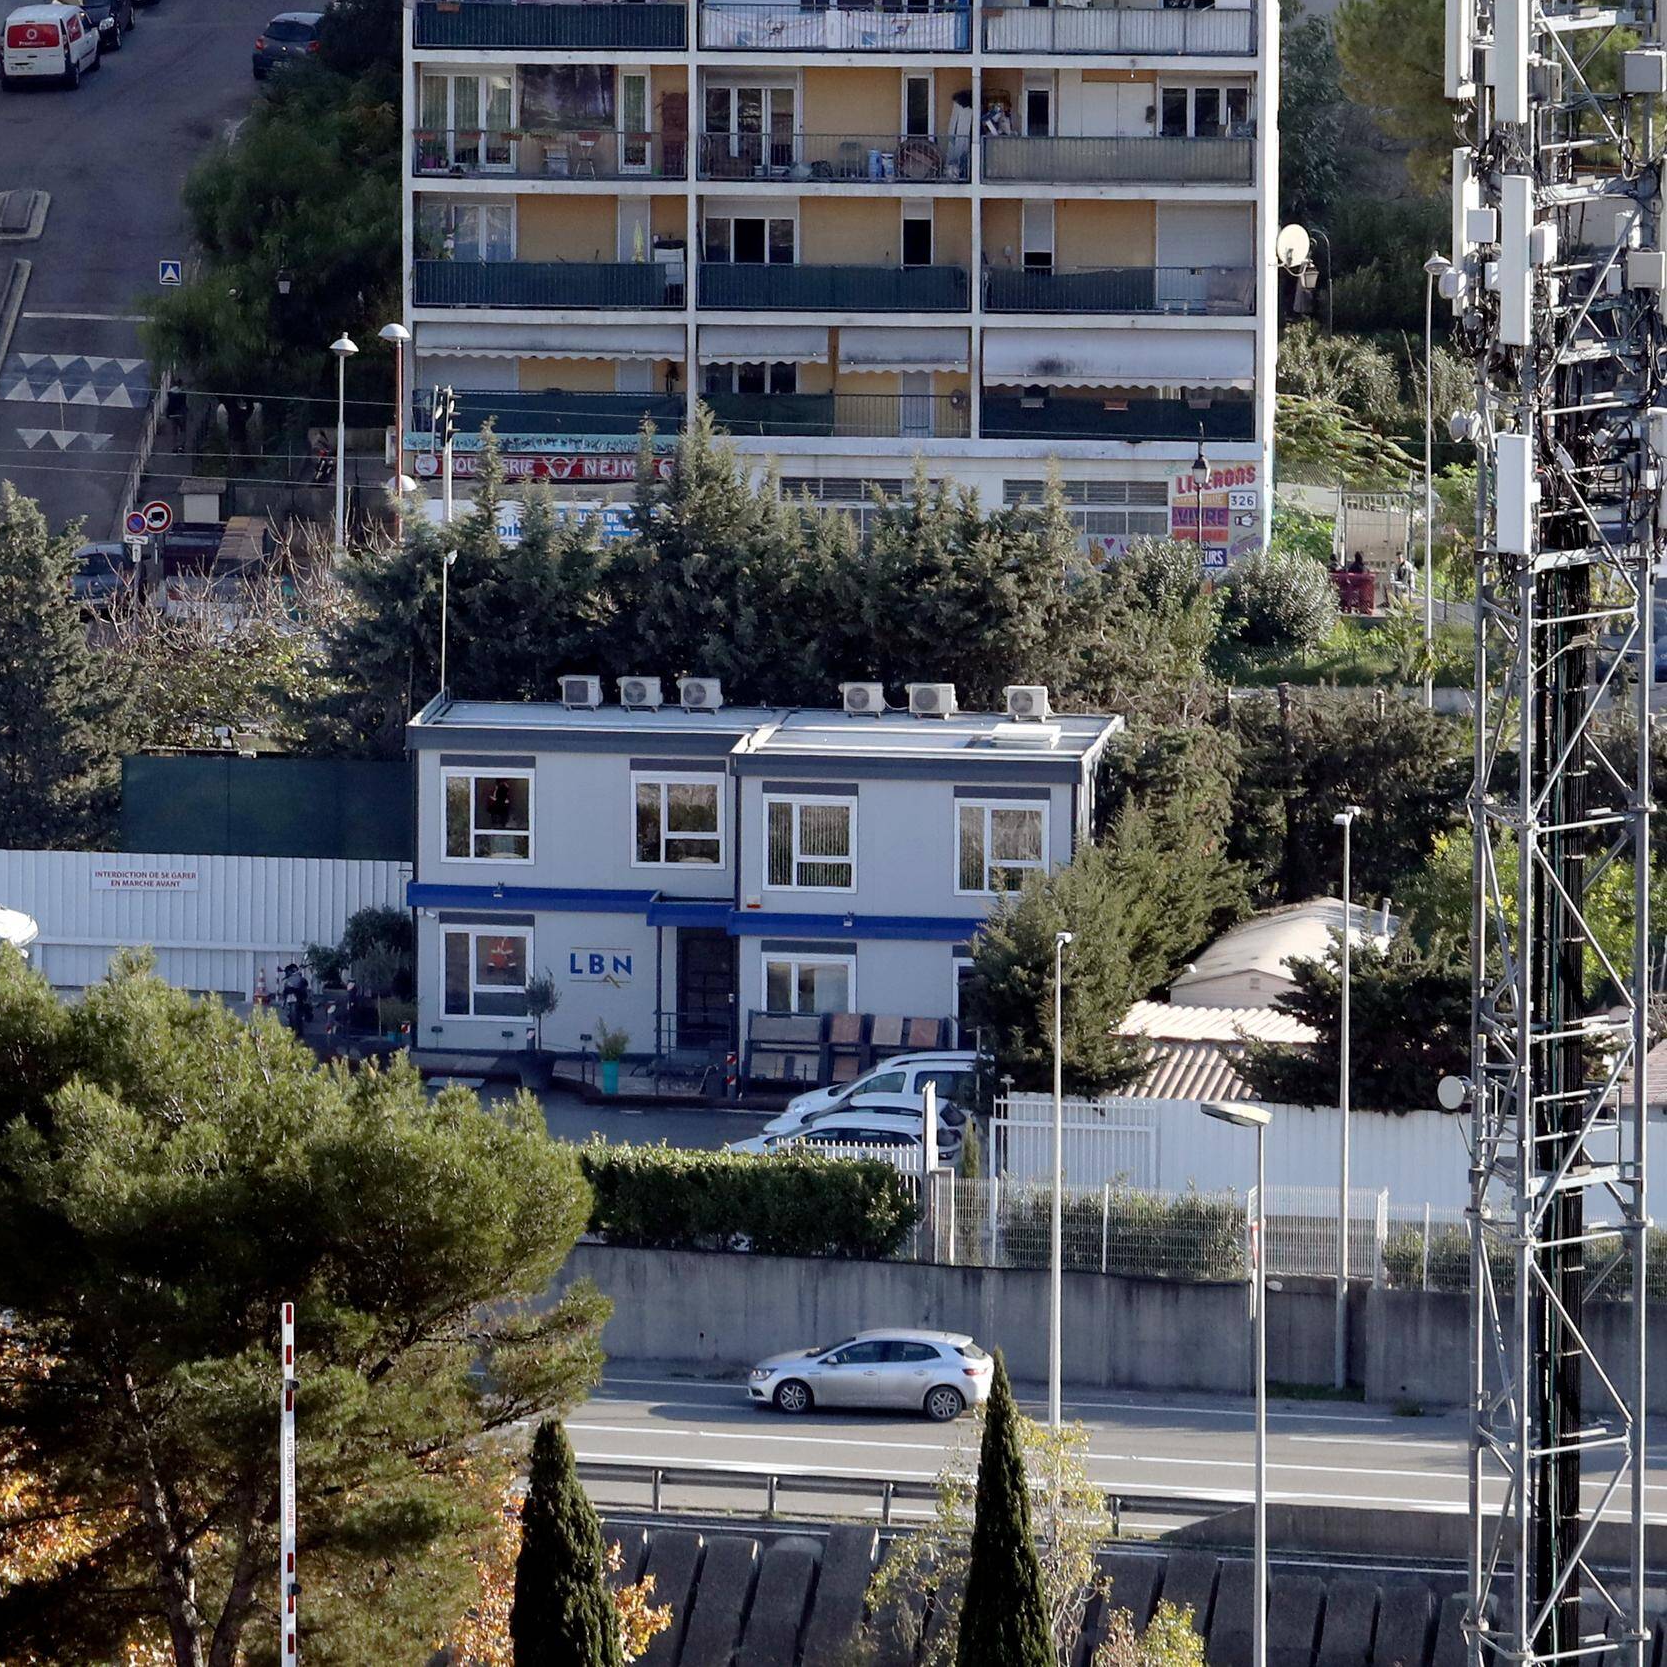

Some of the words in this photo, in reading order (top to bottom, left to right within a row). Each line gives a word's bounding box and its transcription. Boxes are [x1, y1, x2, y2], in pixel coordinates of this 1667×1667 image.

[584, 459, 638, 475] NEJM
[1231, 495, 1254, 506] 326
[95, 871, 147, 879] INTERDICTION
[570, 953, 632, 975] LBN
[286, 1494, 294, 1528] FERMEE
